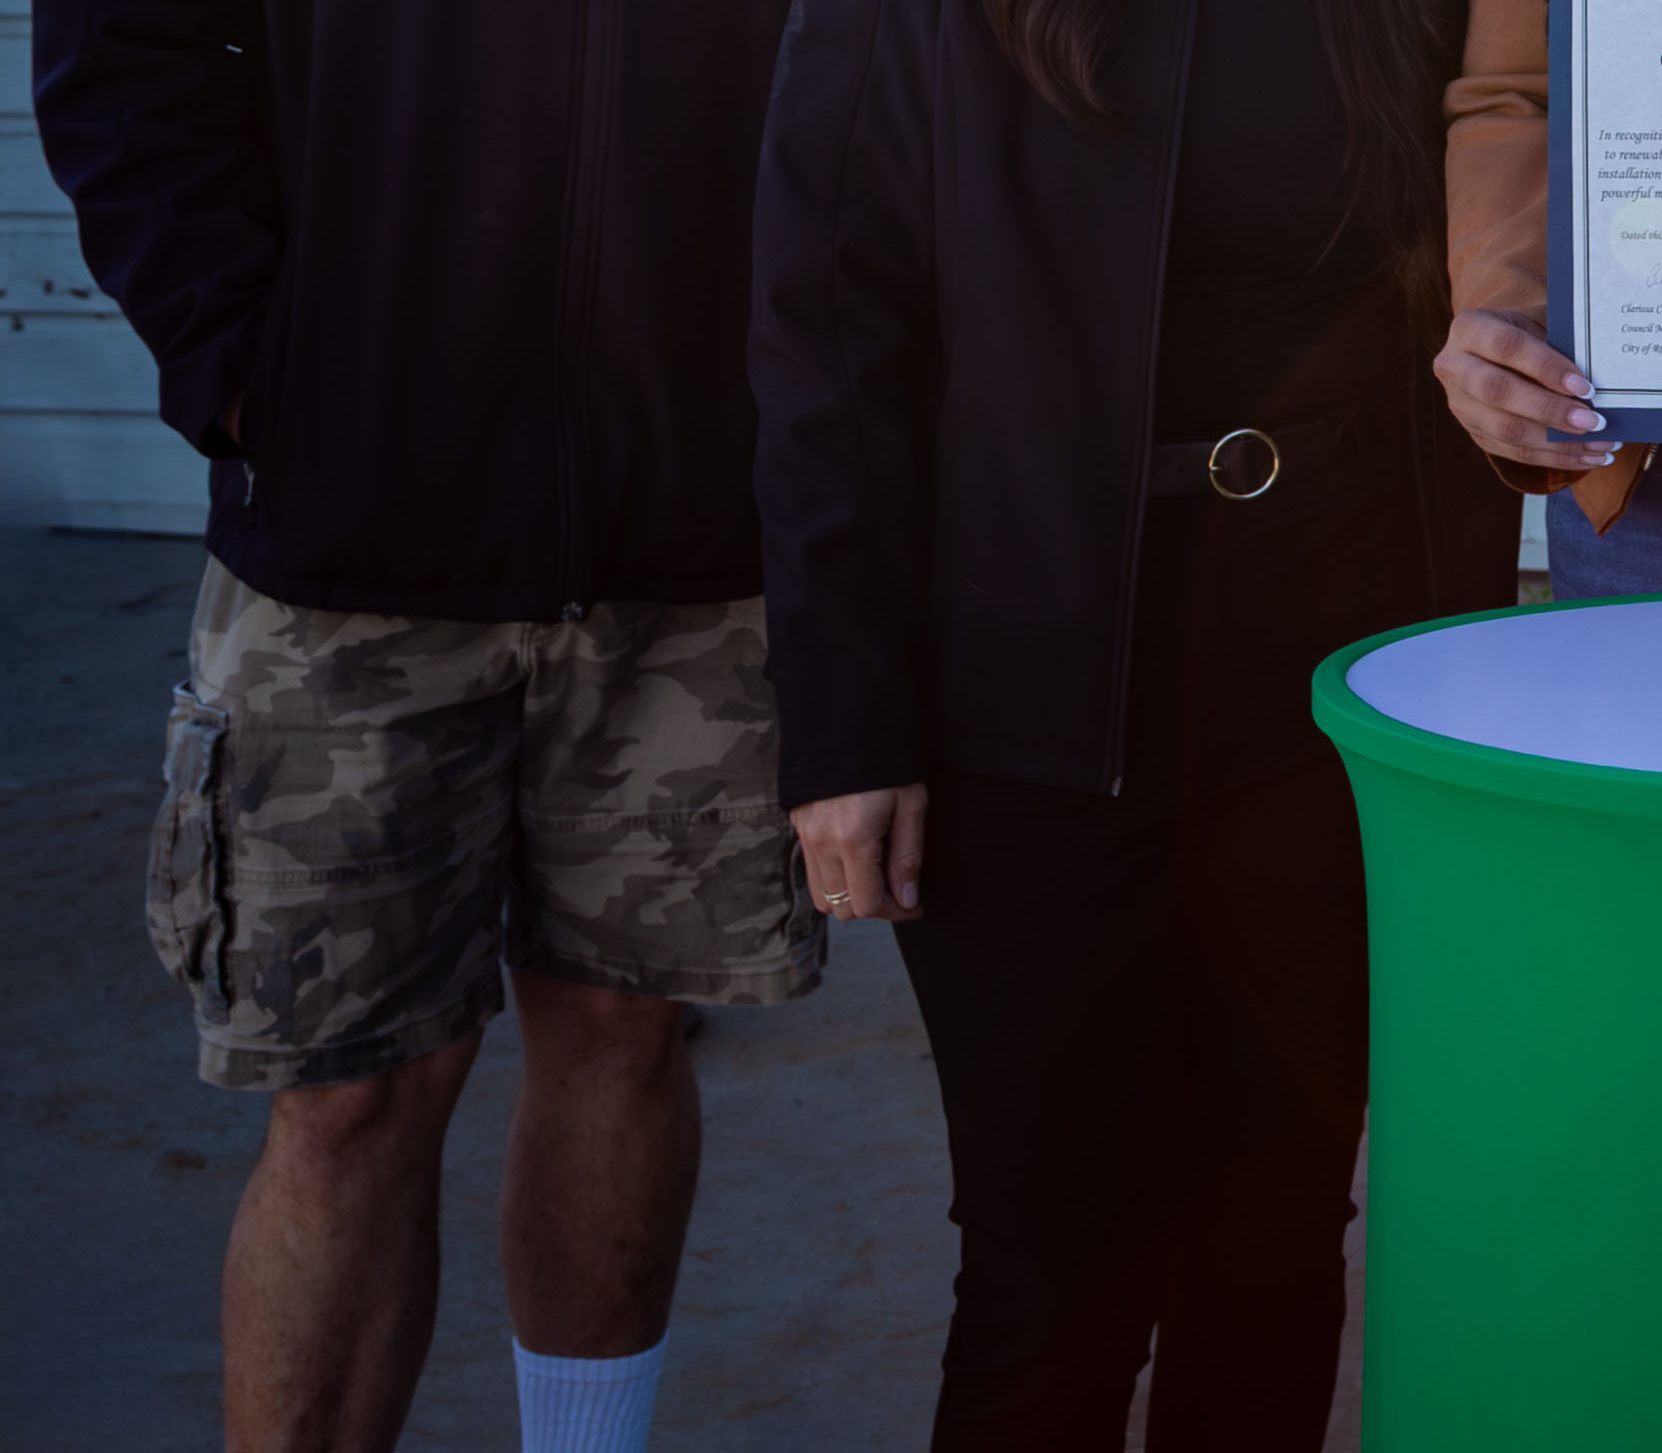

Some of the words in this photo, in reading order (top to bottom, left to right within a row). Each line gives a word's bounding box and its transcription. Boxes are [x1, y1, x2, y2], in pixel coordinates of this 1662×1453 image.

[1599, 130, 1612, 141] In
[1605, 151, 1616, 161] to
[1598, 167, 1661, 180] installation
[1601, 186, 1653, 203] powerful
